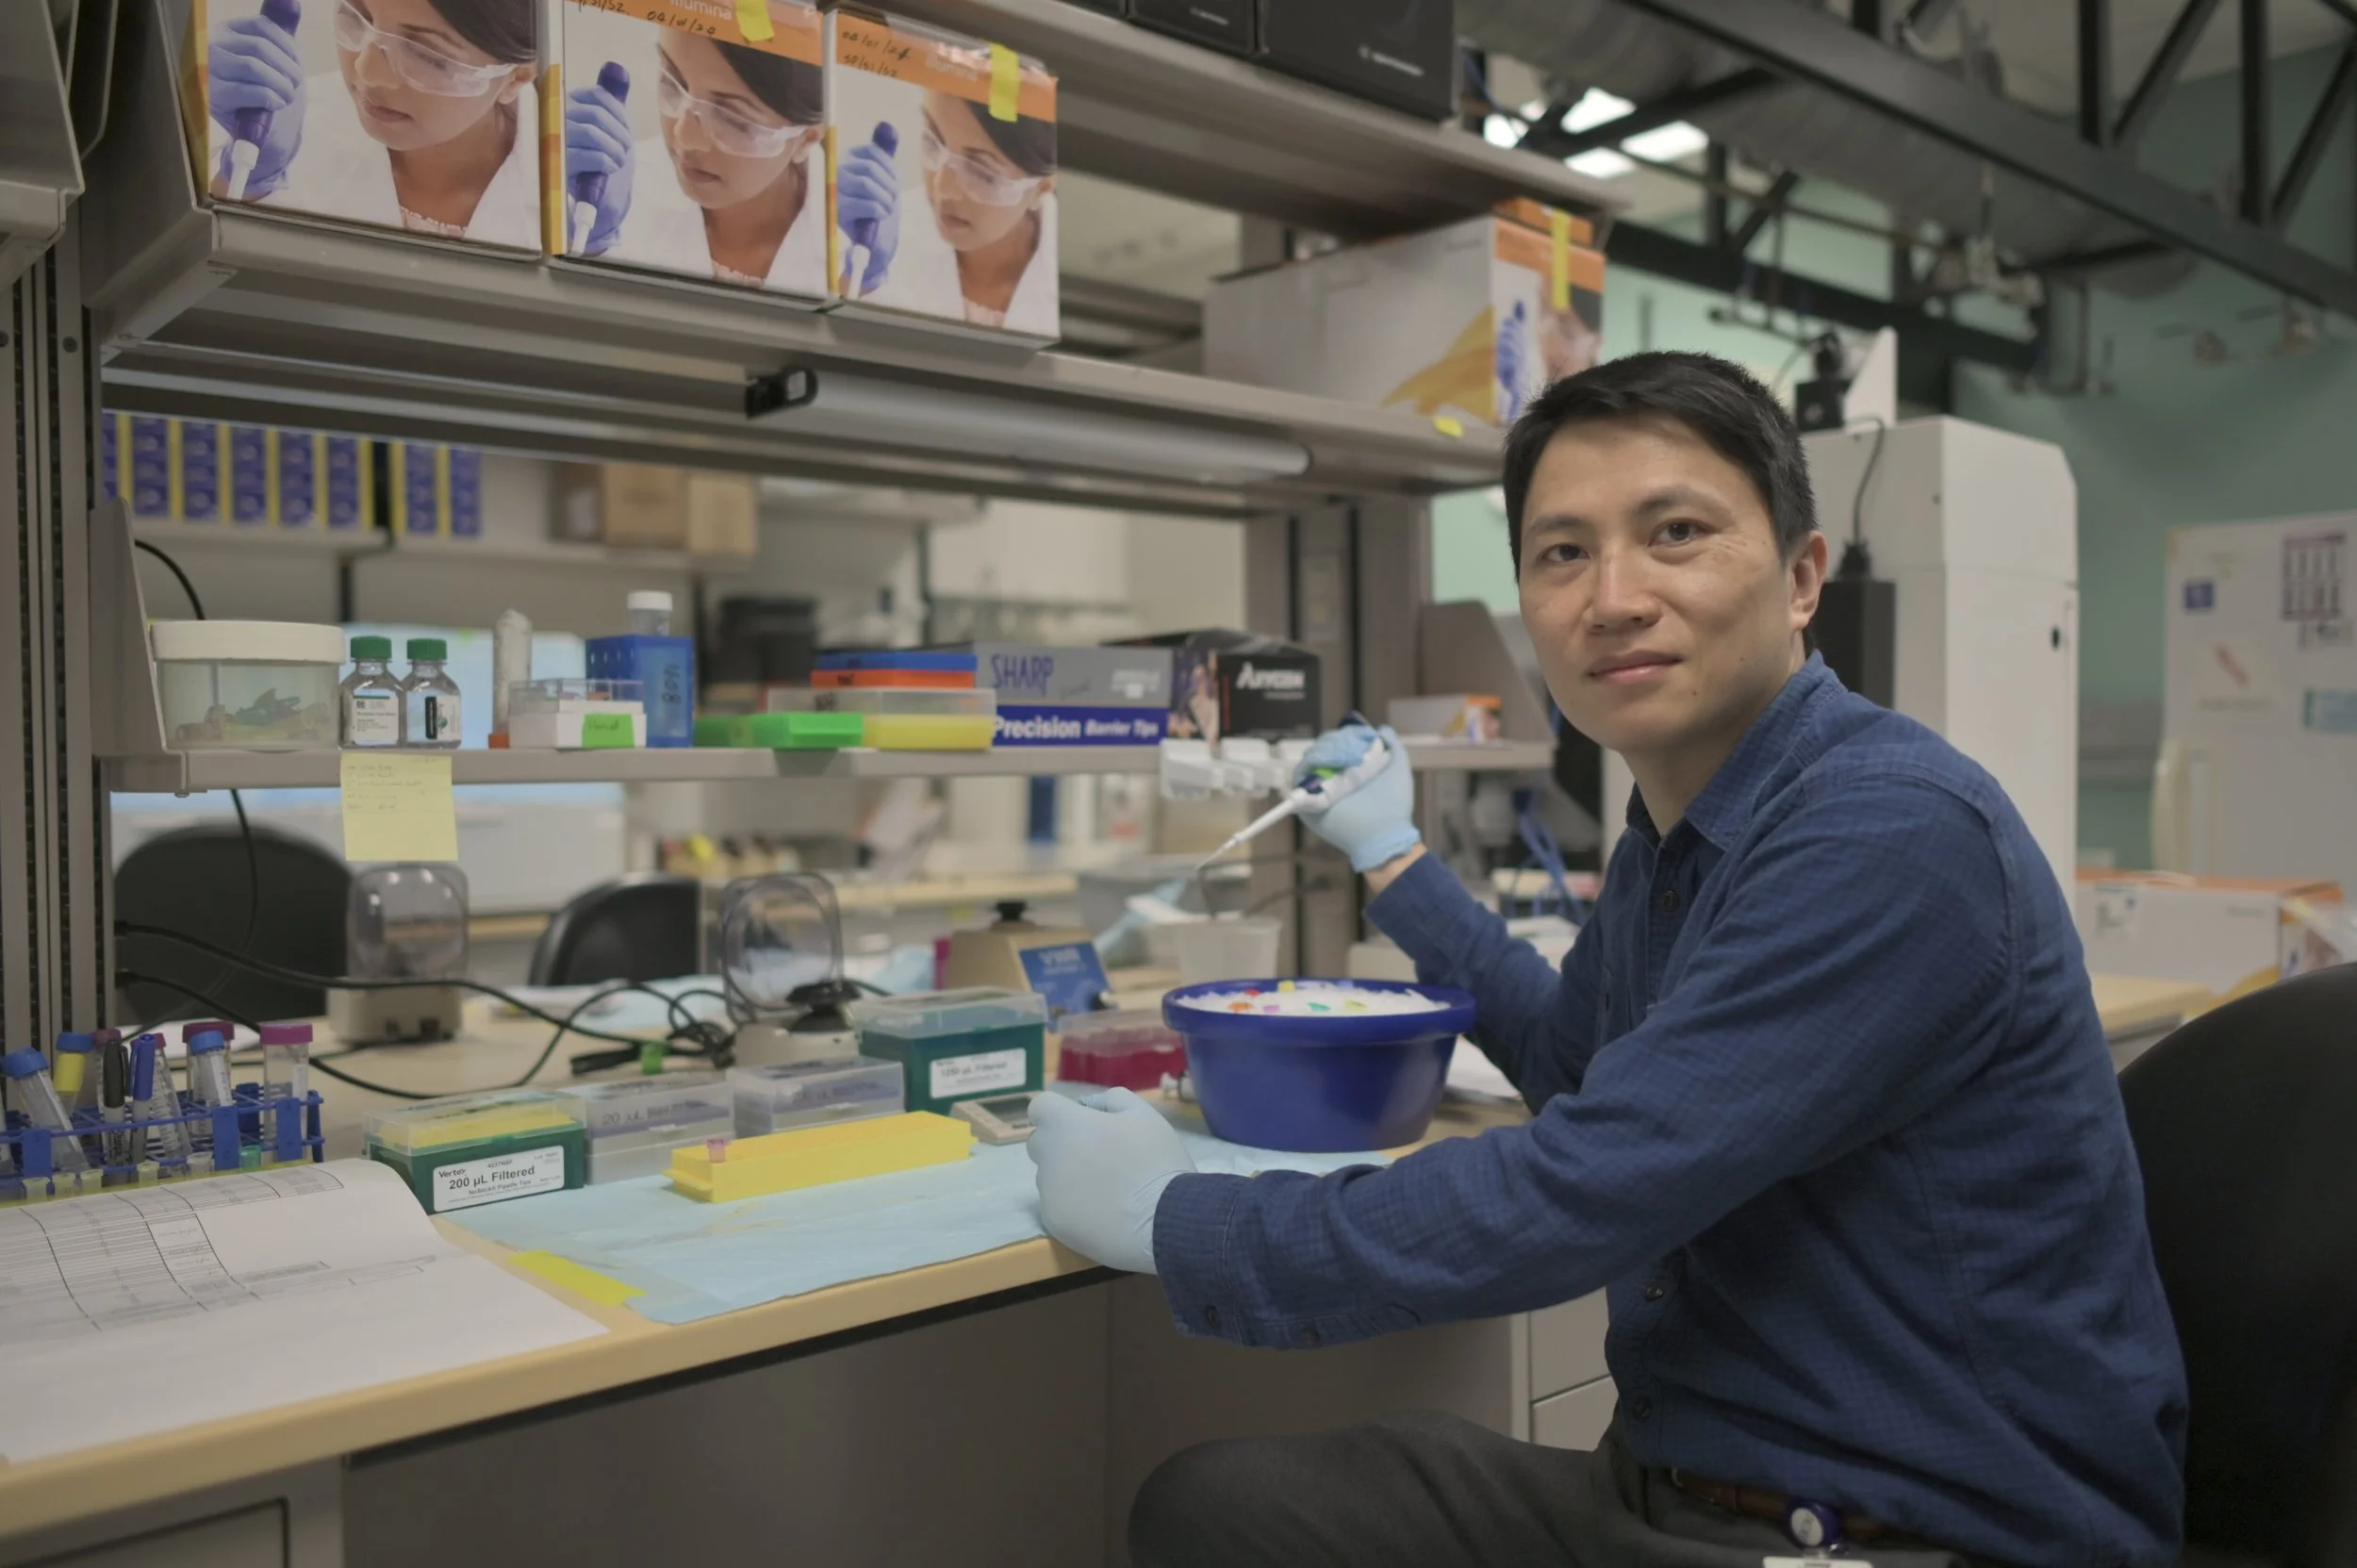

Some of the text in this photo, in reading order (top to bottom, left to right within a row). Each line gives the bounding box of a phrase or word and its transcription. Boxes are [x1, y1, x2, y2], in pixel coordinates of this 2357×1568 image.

[991, 652, 1054, 698] SHARP
[995, 715, 1159, 740] Precision Barrier Tips
[602, 1113, 620, 1126] 20
[449, 1177, 470, 1189] 200
[473, 1175, 488, 1187] µL
[491, 1165, 535, 1181] Filtered
